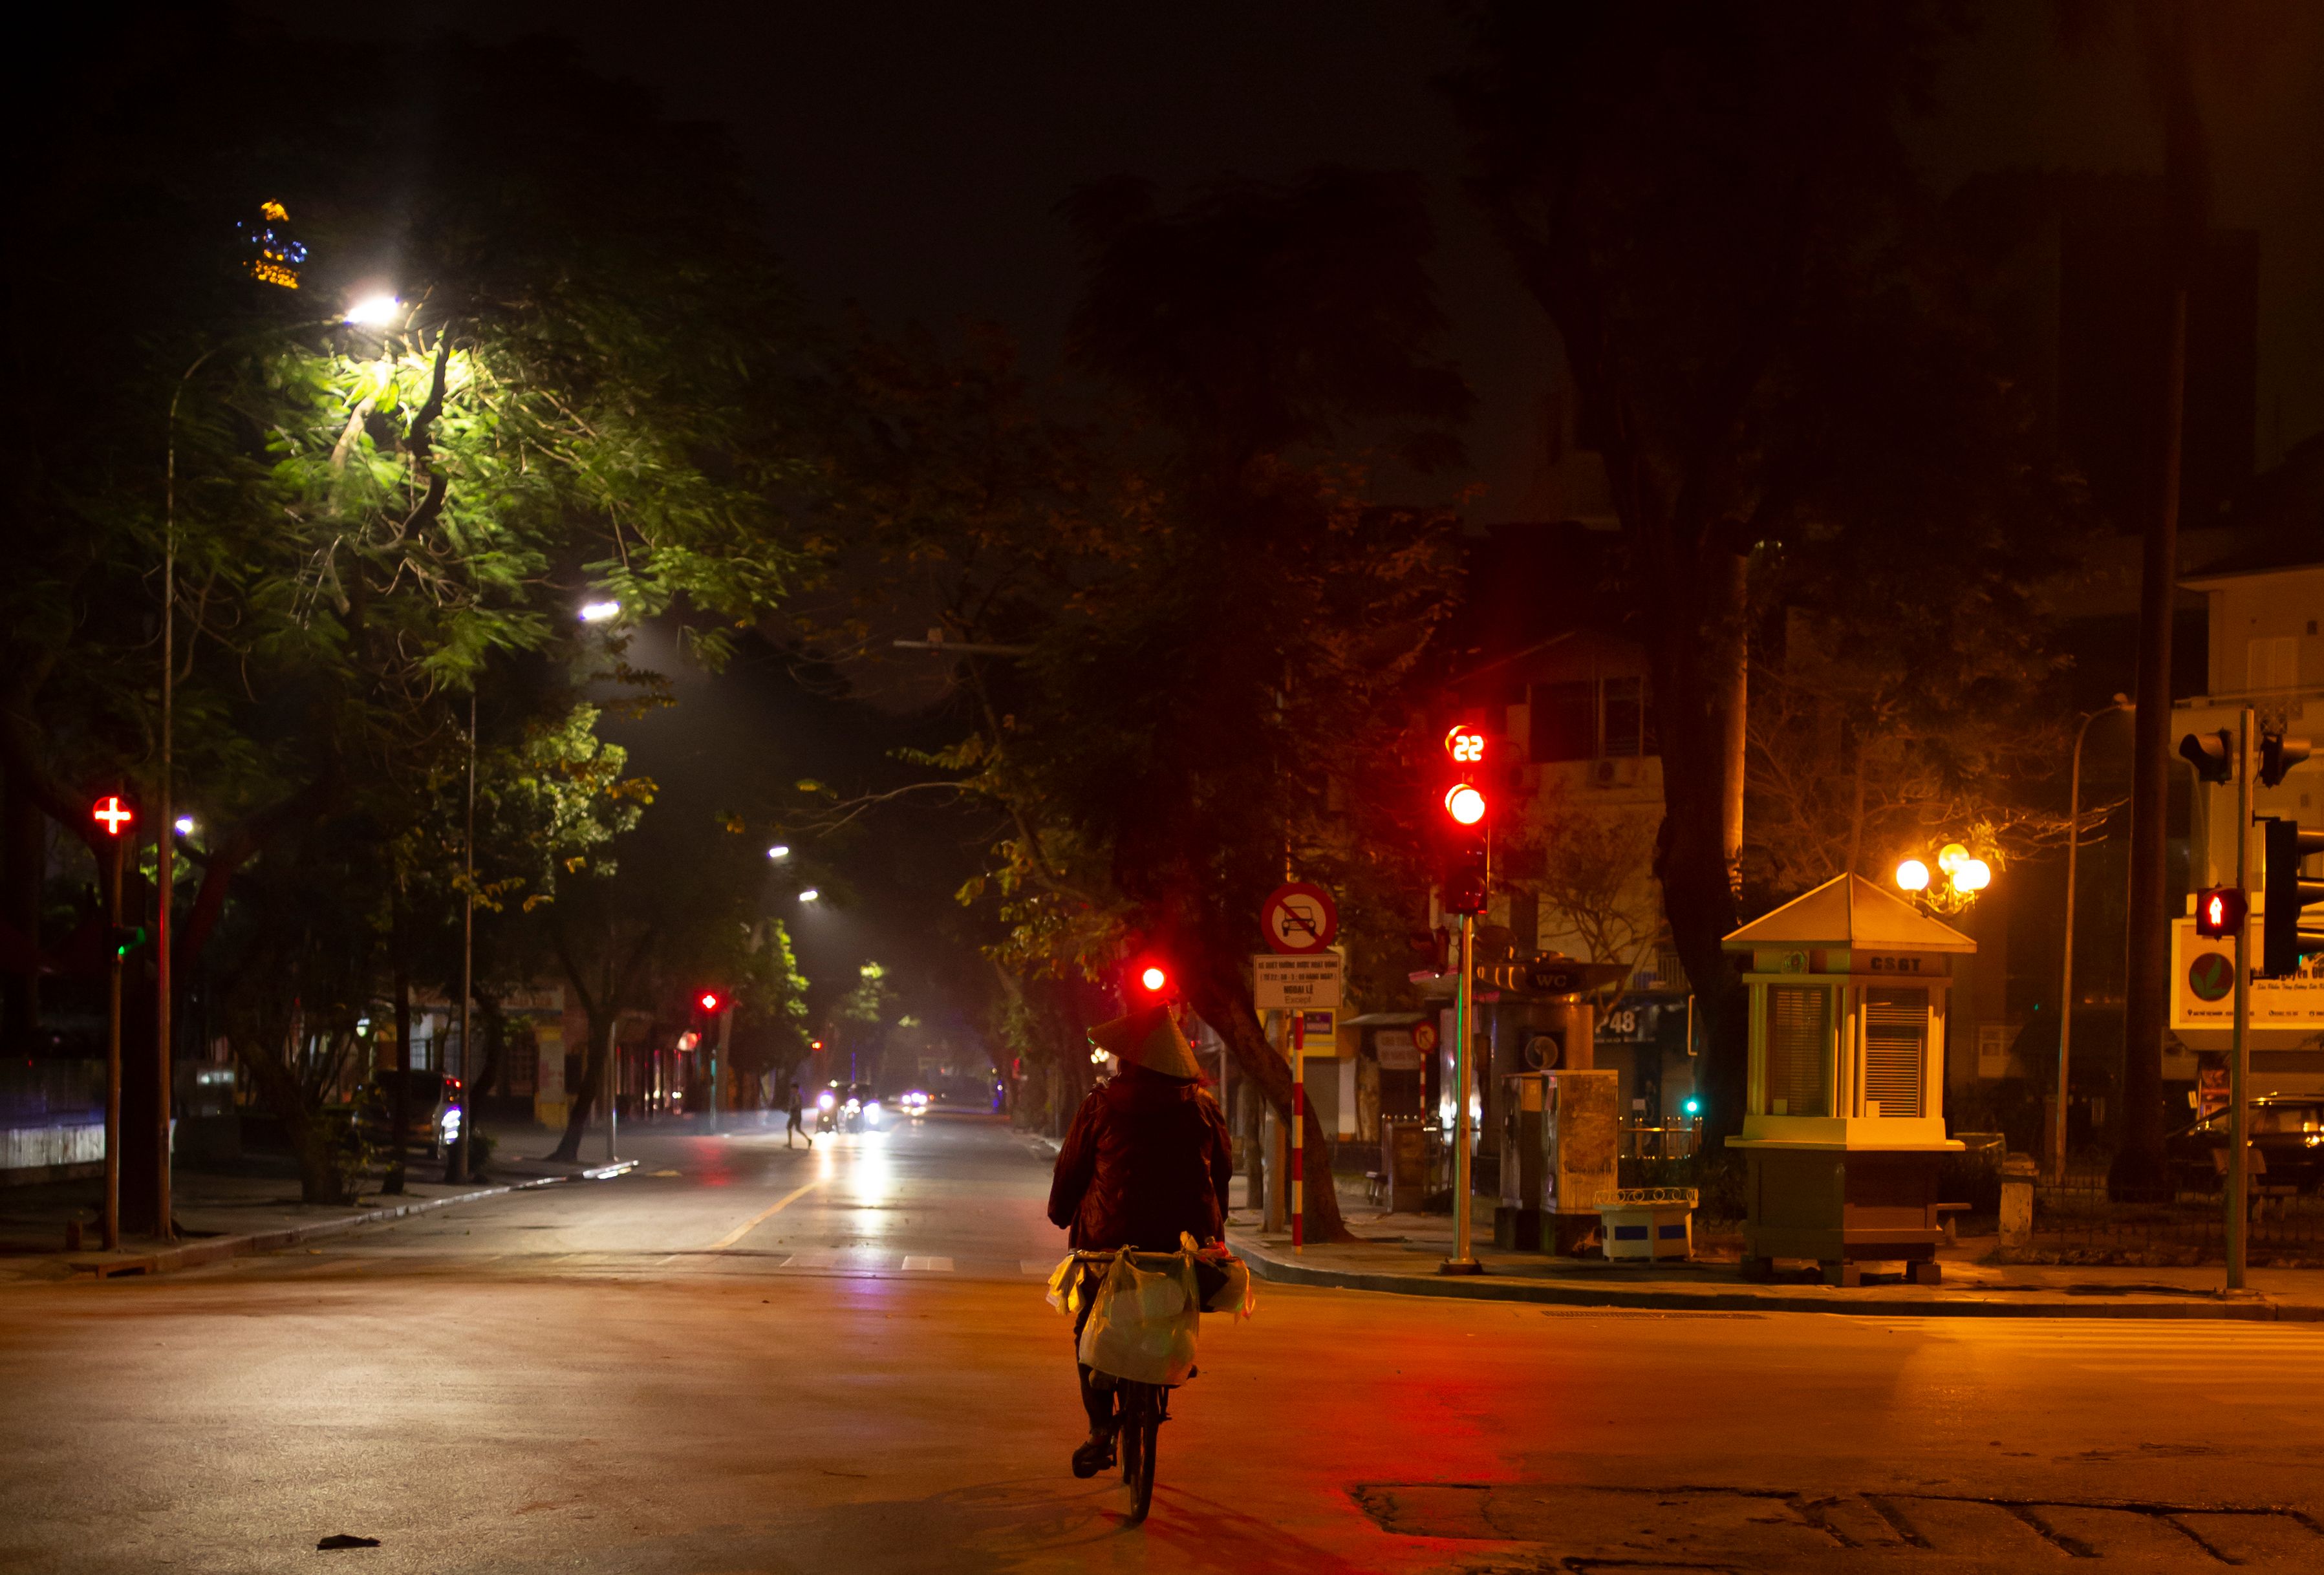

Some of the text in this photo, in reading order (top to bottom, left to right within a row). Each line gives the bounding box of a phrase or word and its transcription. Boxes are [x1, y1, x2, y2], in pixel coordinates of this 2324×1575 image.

[1454, 735, 1483, 761] 22
[1871, 958, 1921, 971] CSGT
[1536, 975, 1567, 987] WC
